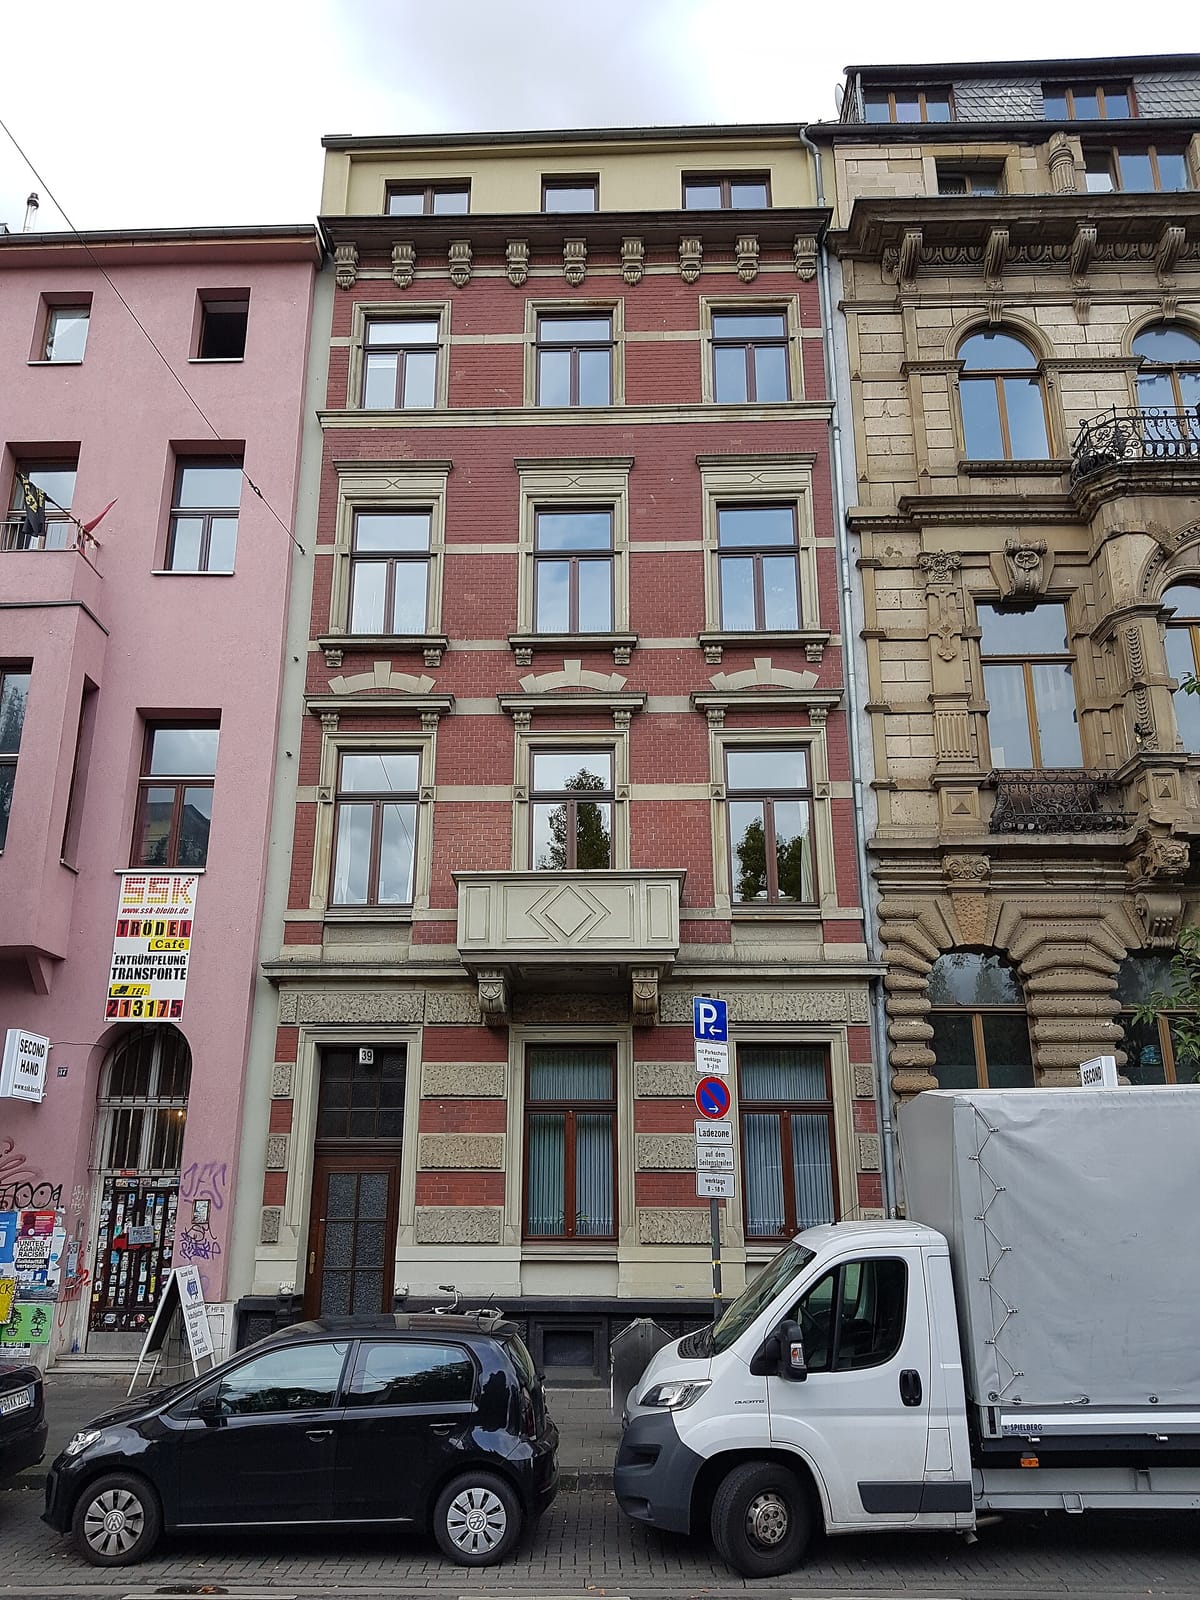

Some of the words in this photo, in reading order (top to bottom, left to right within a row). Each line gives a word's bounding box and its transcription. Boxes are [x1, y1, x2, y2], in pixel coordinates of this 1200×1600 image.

[123, 877, 195, 904] SSK
[118, 919, 191, 936] TRÖDEL
[155, 939, 185, 949] Café
[114, 954, 186, 966] ENTRÜMPELUNG
[112, 967, 187, 980] TRANSPORTE
[106, 1000, 183, 1017] 213175
[699, 1003, 718, 1035] P
[20, 1038, 45, 1058] SECOND
[361, 1050, 372, 1061] 39
[20, 1059, 39, 1076] HAND
[1083, 1066, 1101, 1085] SECOND
[698, 1127, 730, 1138] Ladezone
[699, 1159, 733, 1167] Seitenstreifen
